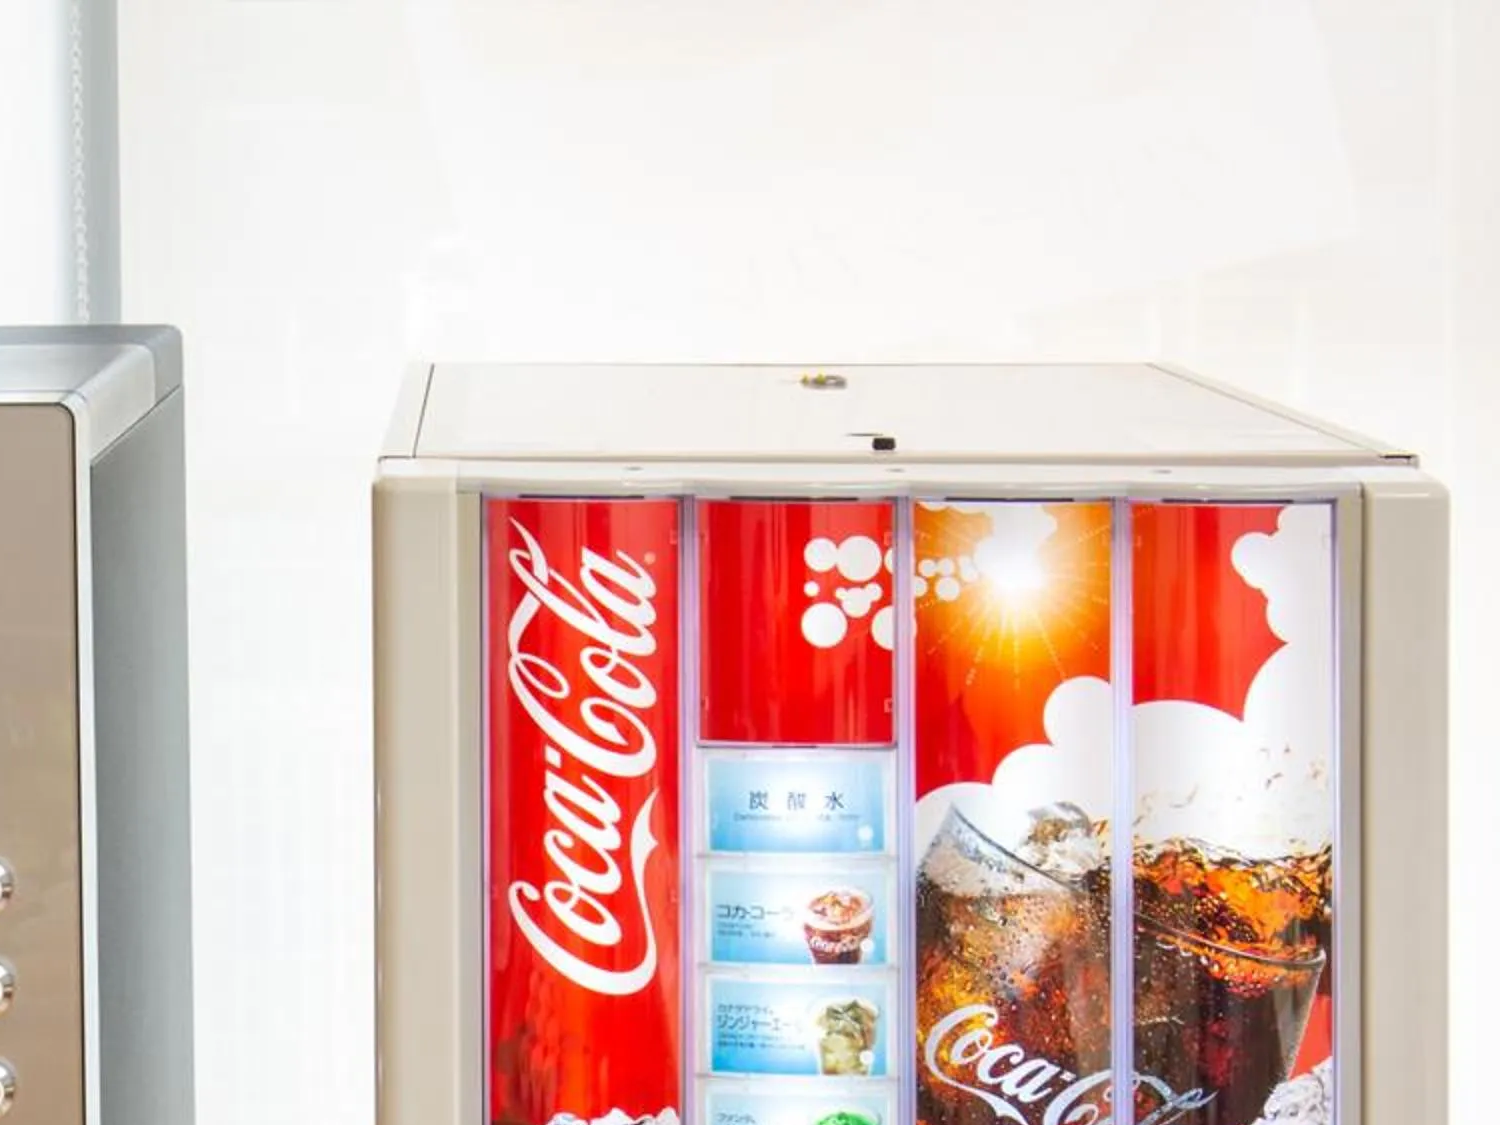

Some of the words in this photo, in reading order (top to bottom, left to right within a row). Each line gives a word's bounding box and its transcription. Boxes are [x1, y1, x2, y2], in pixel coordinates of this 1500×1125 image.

[509, 516, 660, 996] Coca-Cola
[749, 791, 844, 811] 炭酸水
[717, 1014, 803, 1032] ジンジャーエー
